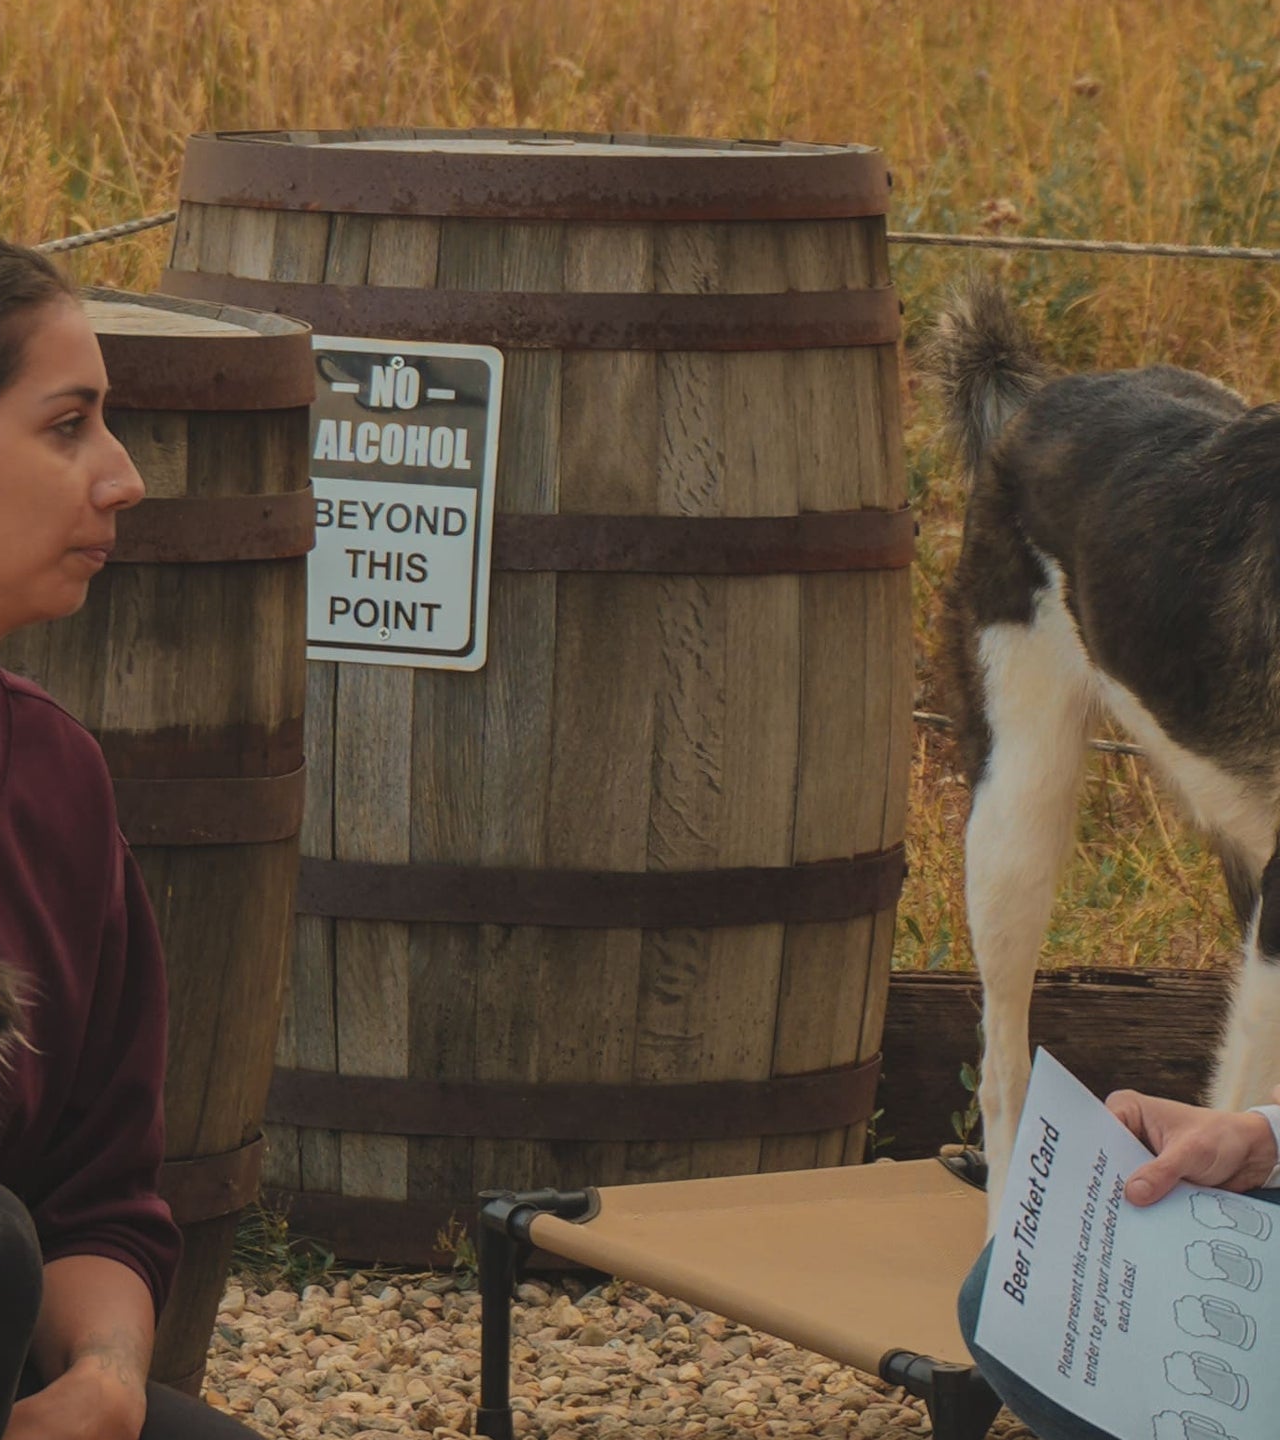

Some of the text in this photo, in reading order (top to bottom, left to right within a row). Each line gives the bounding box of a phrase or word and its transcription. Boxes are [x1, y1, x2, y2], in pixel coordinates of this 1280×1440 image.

[370, 365, 420, 410] NO
[313, 419, 471, 470] ALCOHOL
[315, 498, 467, 537] BEYOND
[345, 548, 428, 584] THIS
[329, 596, 442, 632] POINT
[1003, 1117, 1060, 1305] Beer Ticket Card
[1057, 1148, 1110, 1379] Please present this card to the bar
[1083, 1173, 1125, 1387] tender to get your included beer
[1118, 1259, 1137, 1333] each class!
